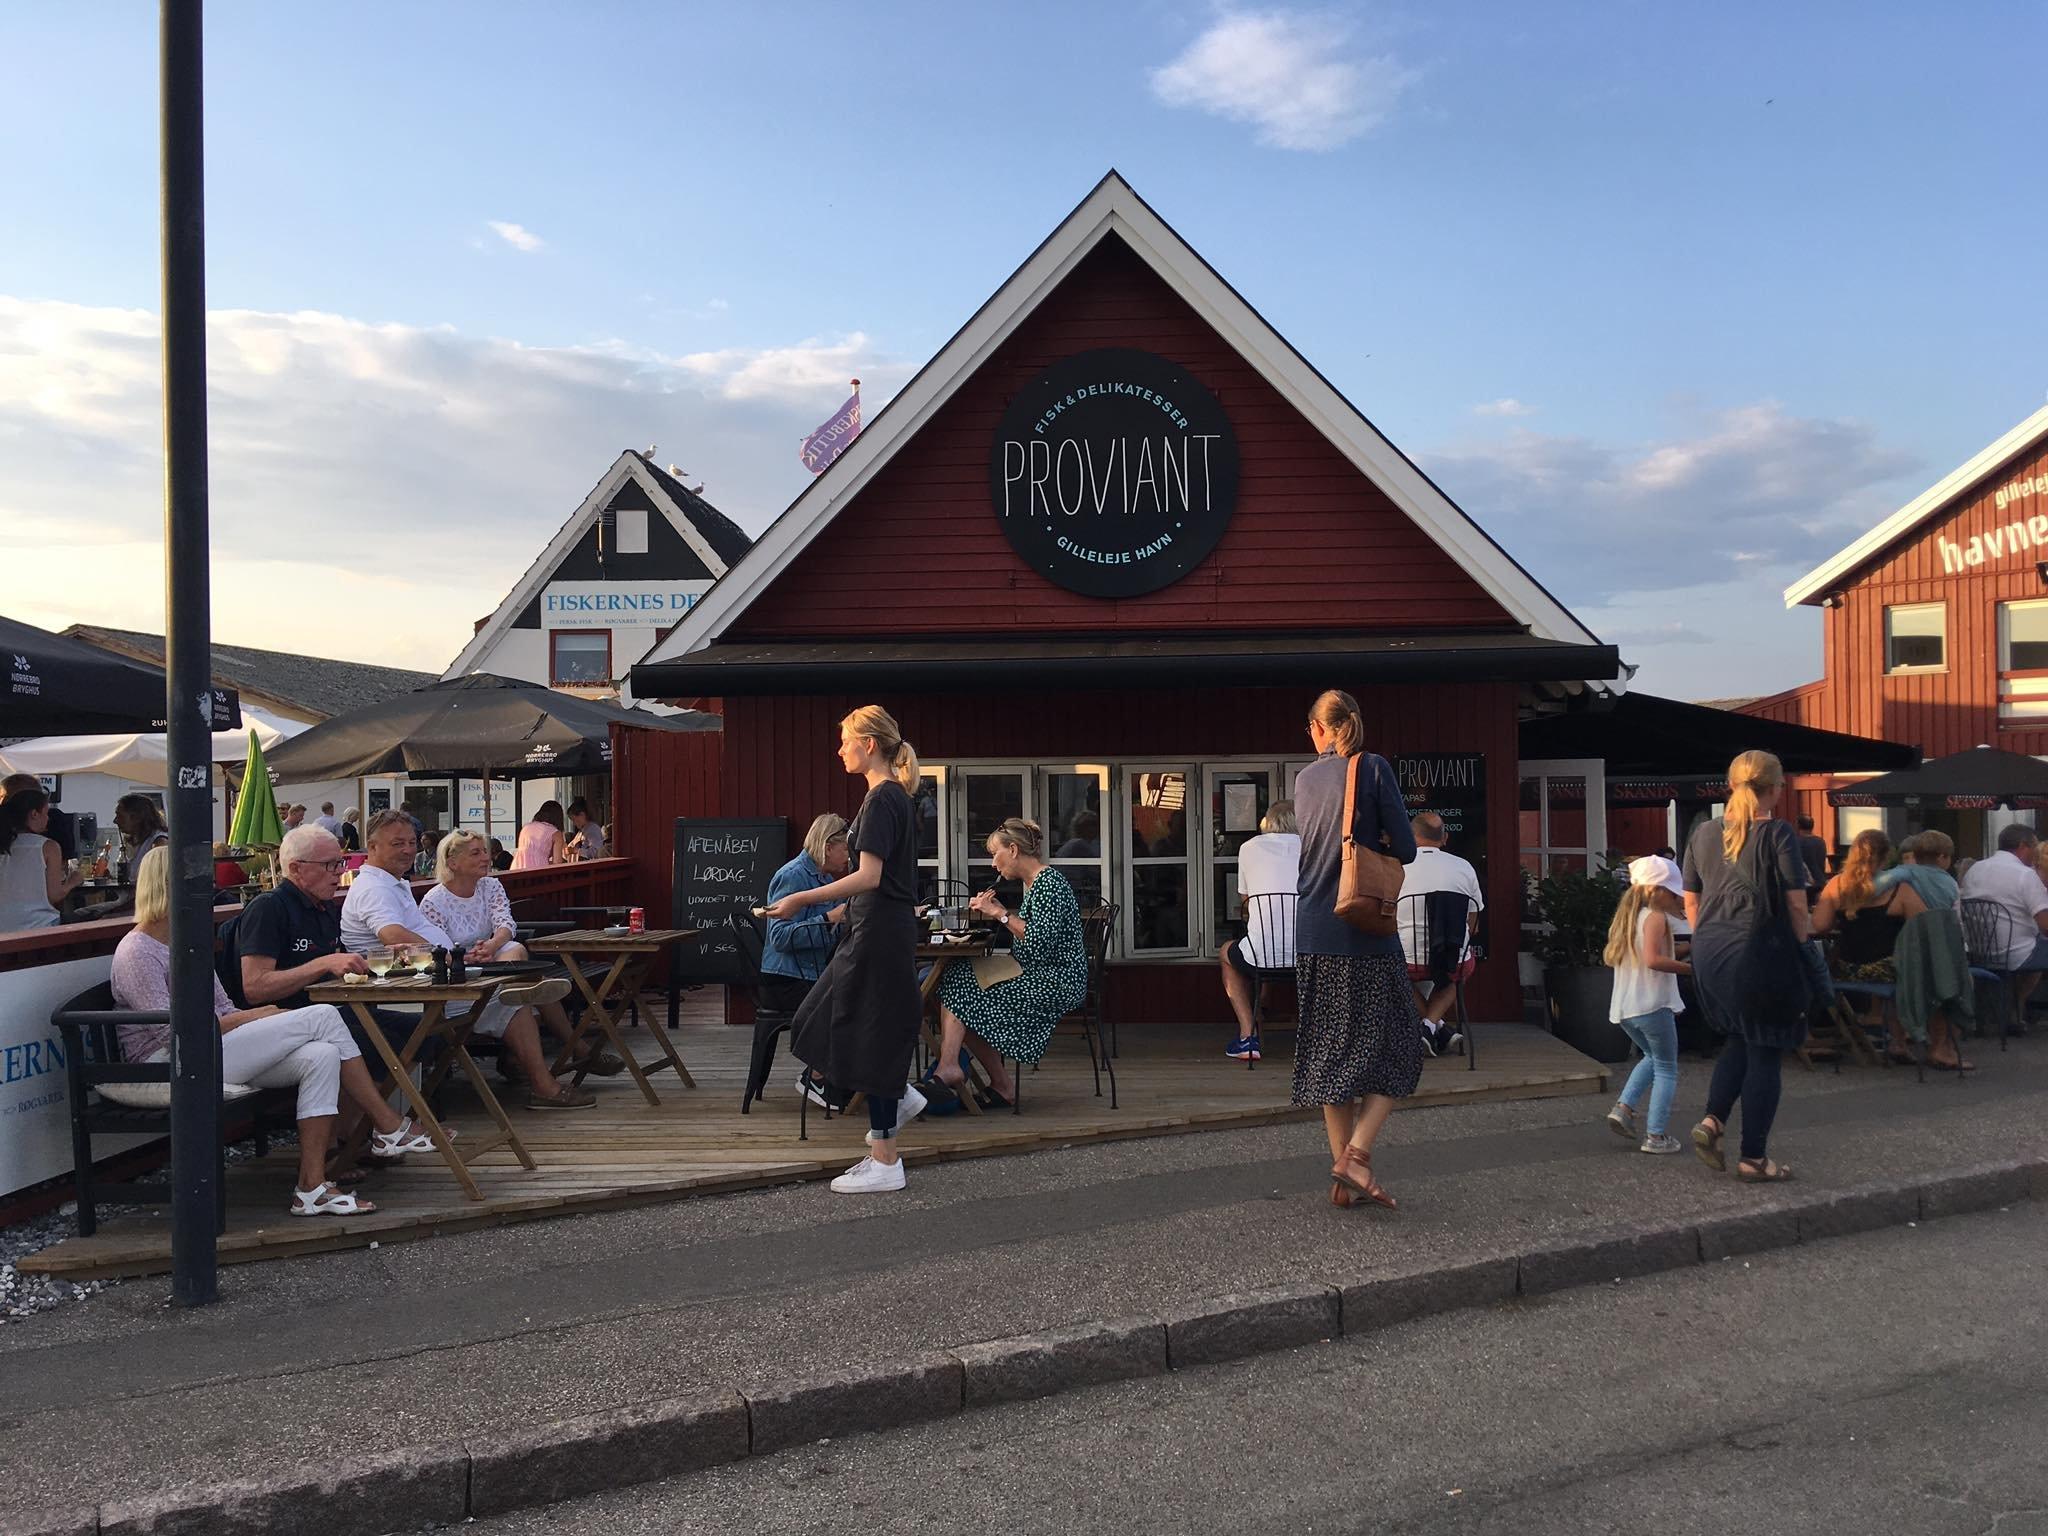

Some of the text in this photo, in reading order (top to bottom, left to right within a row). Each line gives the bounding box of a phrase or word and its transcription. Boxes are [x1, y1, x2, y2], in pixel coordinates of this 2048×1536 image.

[1034, 382, 1189, 434] FISK & DELIKATESSER
[1004, 435, 1221, 517] PROVIANT
[1057, 533, 1173, 564] GILLELEJE HAVN
[1938, 514, 2048, 574] havne
[547, 593, 703, 610] FISKERNES DE
[12, 684, 40, 696] BRYGHUS
[40, 777, 53, 785] TM
[1399, 758, 1479, 788] PROVIANT
[463, 783, 513, 791] FISKRNES
[1442, 823, 1464, 832] RØD
